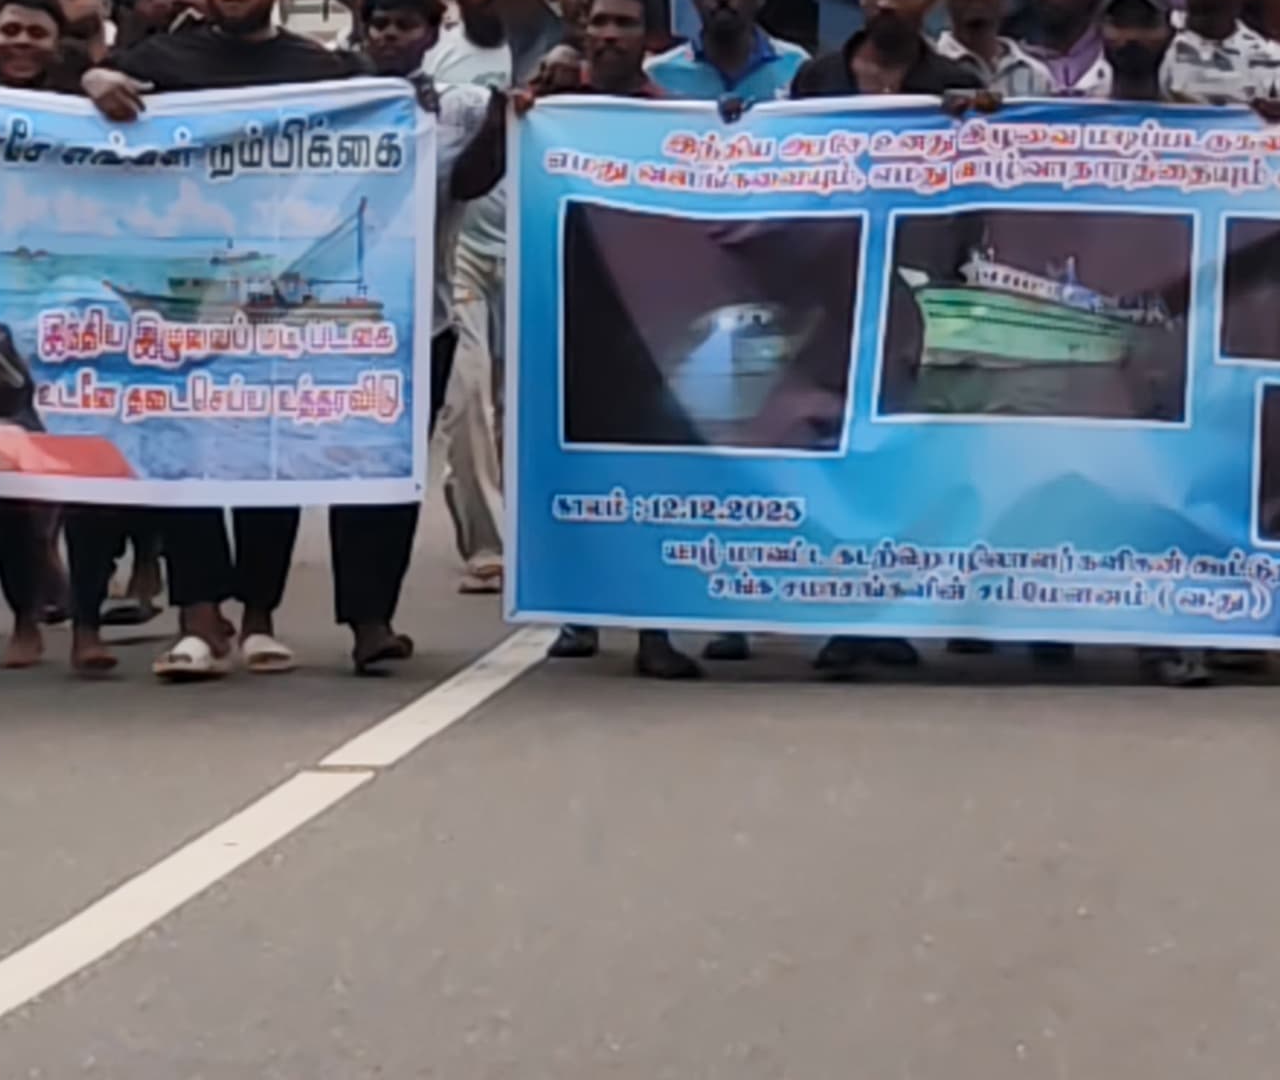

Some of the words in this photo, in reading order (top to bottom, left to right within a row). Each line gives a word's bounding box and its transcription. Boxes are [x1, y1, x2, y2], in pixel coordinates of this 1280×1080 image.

[208, 116, 403, 178] நம்பிக்கை
[665, 133, 771, 162] இந்திய
[41, 309, 125, 358] இந்திய
